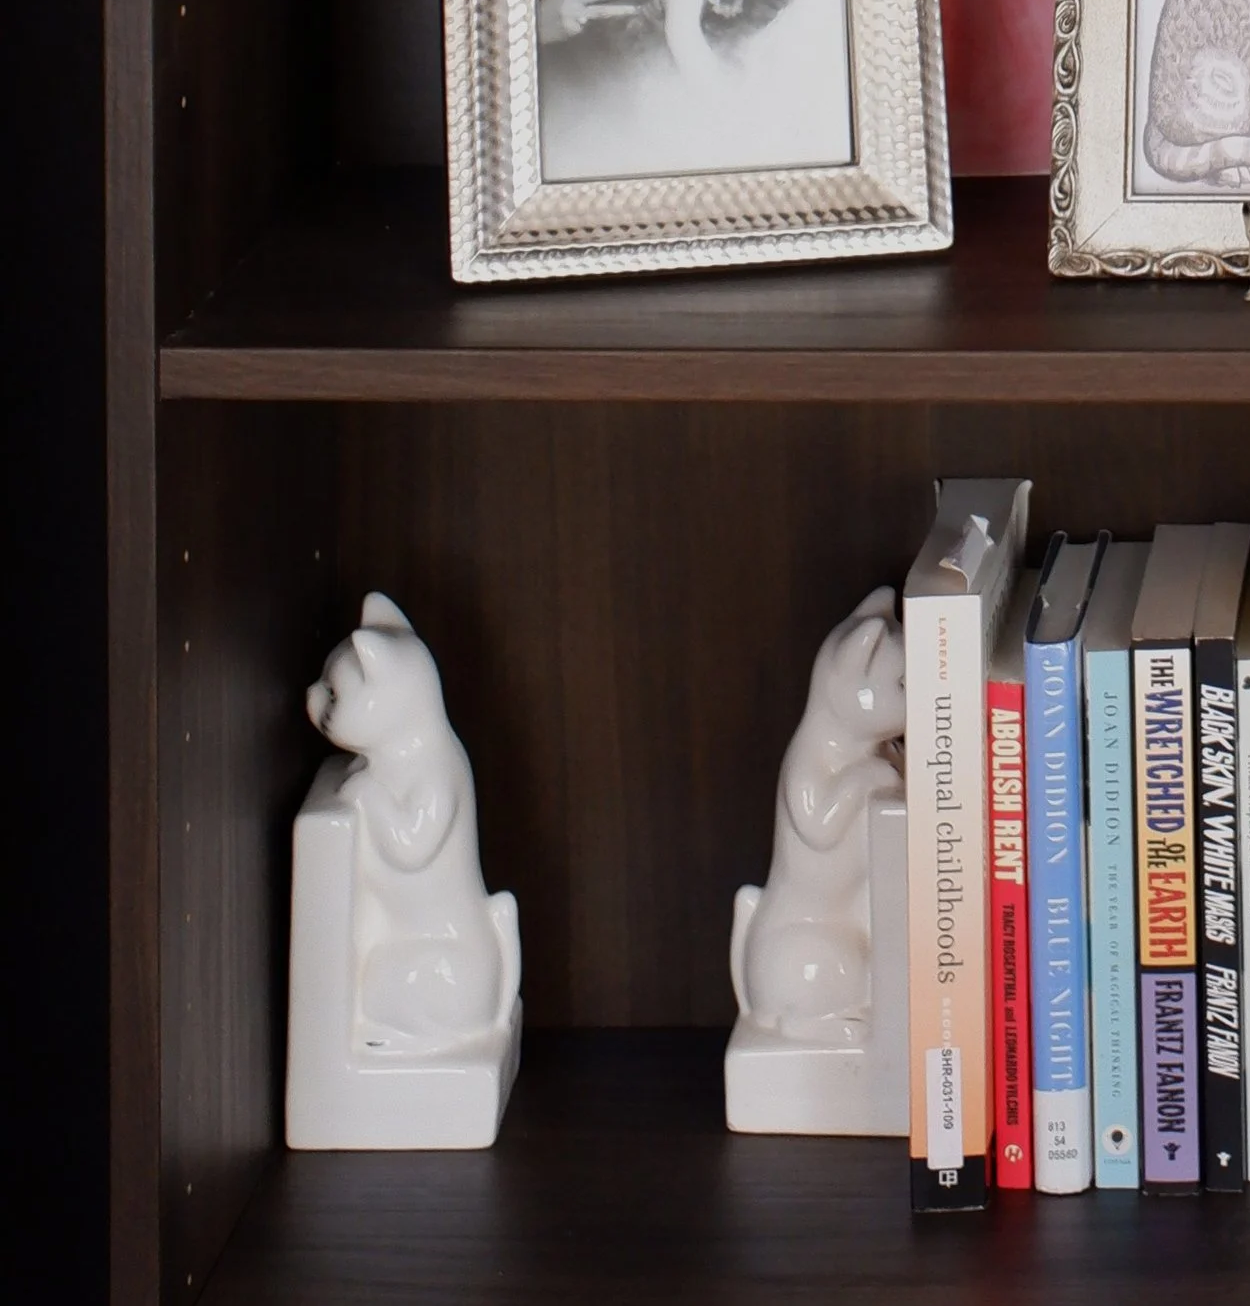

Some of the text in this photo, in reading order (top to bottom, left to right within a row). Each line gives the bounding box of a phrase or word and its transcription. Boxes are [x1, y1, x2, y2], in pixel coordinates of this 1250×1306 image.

[926, 693, 965, 985] unequal childhoods
[990, 707, 1025, 886] ABOLISH RENT
[940, 1048, 955, 1131] SHR-031-109
